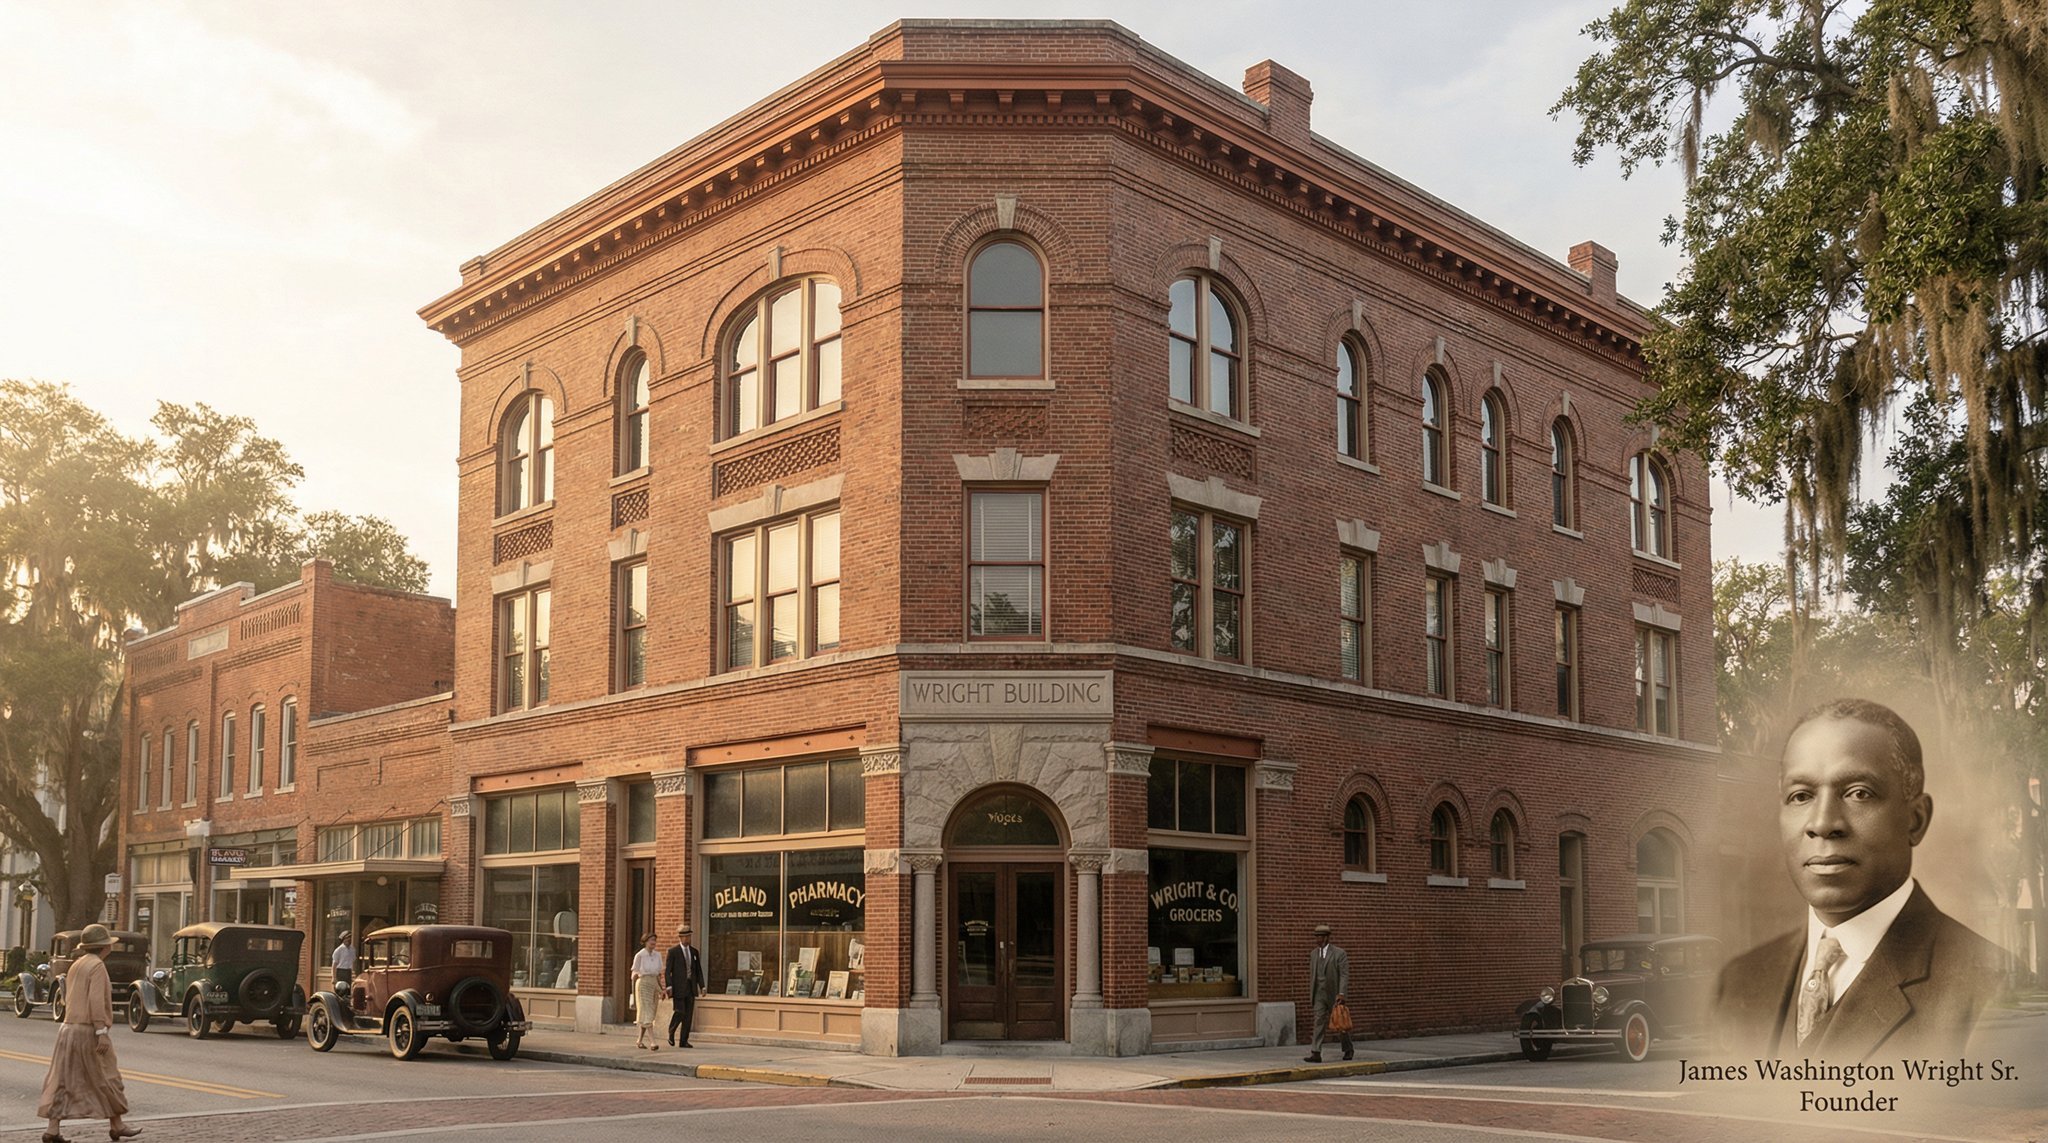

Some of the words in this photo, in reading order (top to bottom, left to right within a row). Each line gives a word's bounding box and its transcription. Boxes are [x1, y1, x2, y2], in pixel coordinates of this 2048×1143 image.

[912, 682, 995, 704] WRIGHT
[1004, 682, 1101, 704] BUILDING
[715, 885, 767, 910] DELAND
[788, 881, 866, 910] PHARMACY
[1151, 881, 1204, 910] WRIGHT
[1206, 884, 1217, 901] &
[1169, 908, 1223, 922] GROCERS
